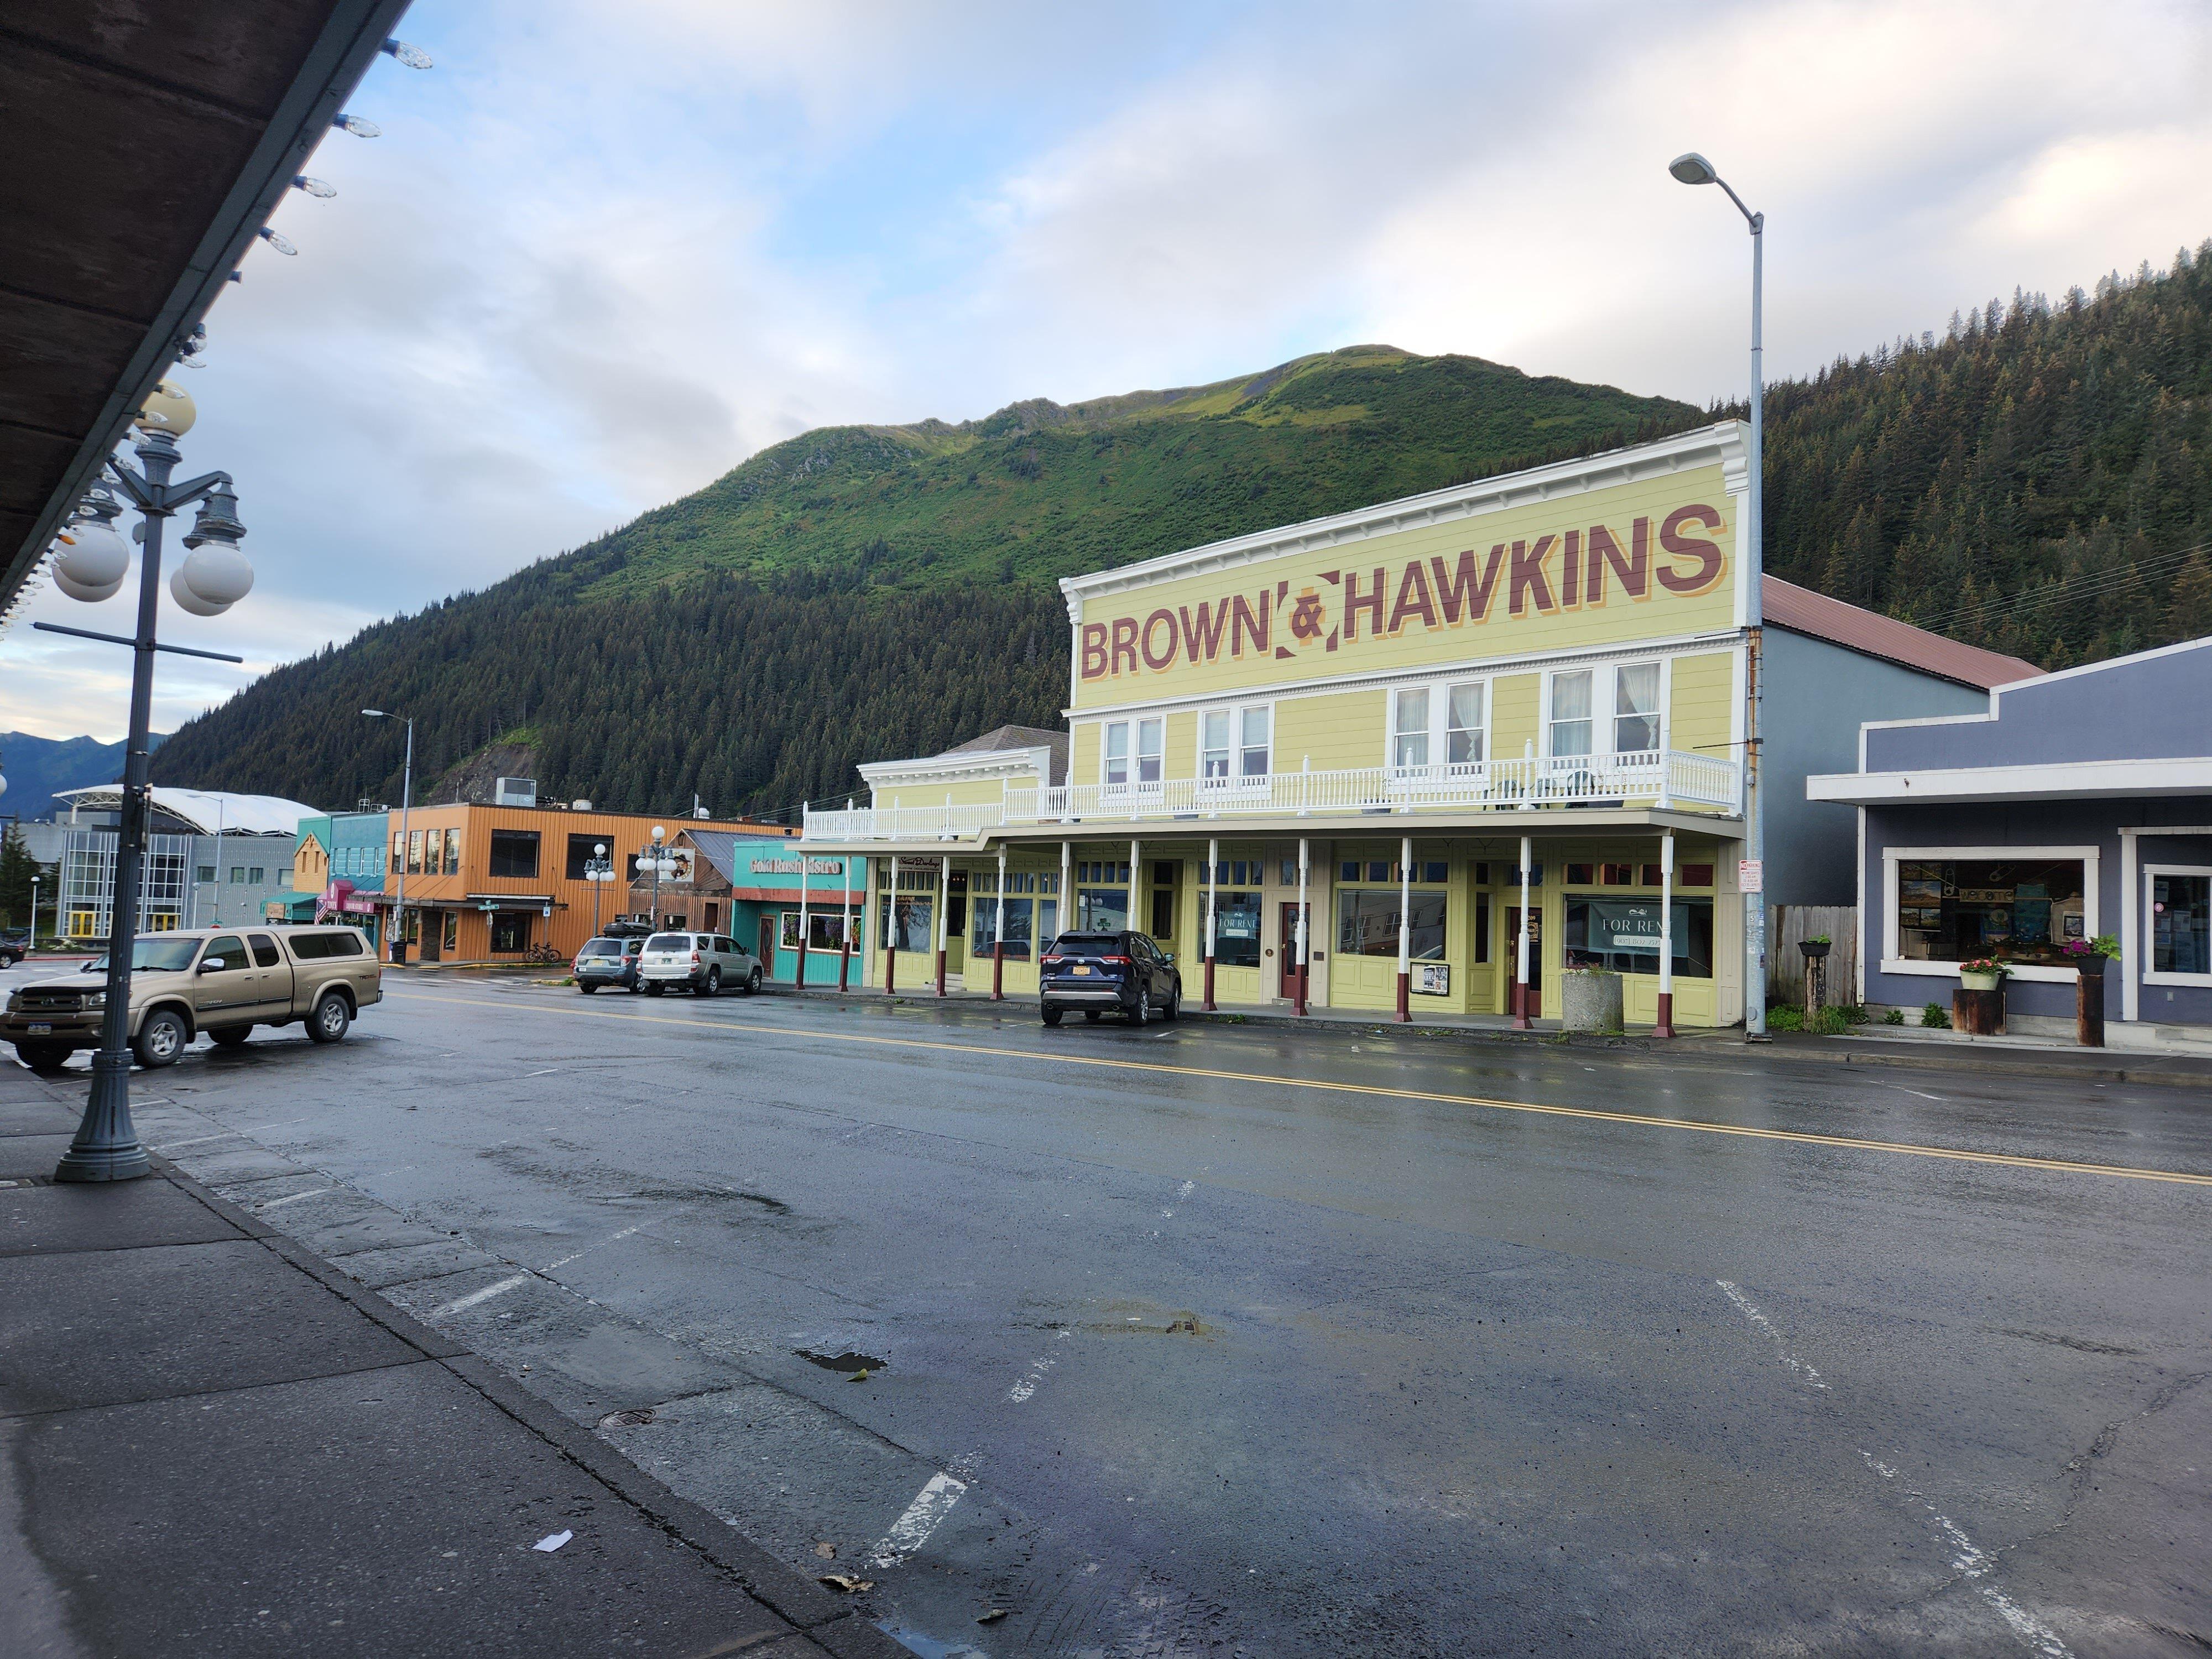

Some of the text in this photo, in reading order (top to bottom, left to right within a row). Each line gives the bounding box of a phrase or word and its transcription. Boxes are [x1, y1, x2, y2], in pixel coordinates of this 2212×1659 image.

[1082, 504, 1725, 681] BROWN & HAWKINS
[750, 858, 774, 873] Gold
[774, 858, 802, 874] Rush
[898, 857, 940, 868] Sweet Darlings
[1219, 919, 1256, 928] FOR RENT
[1603, 919, 1665, 933] FOR REN
[1614, 937, 1631, 946] (907)
